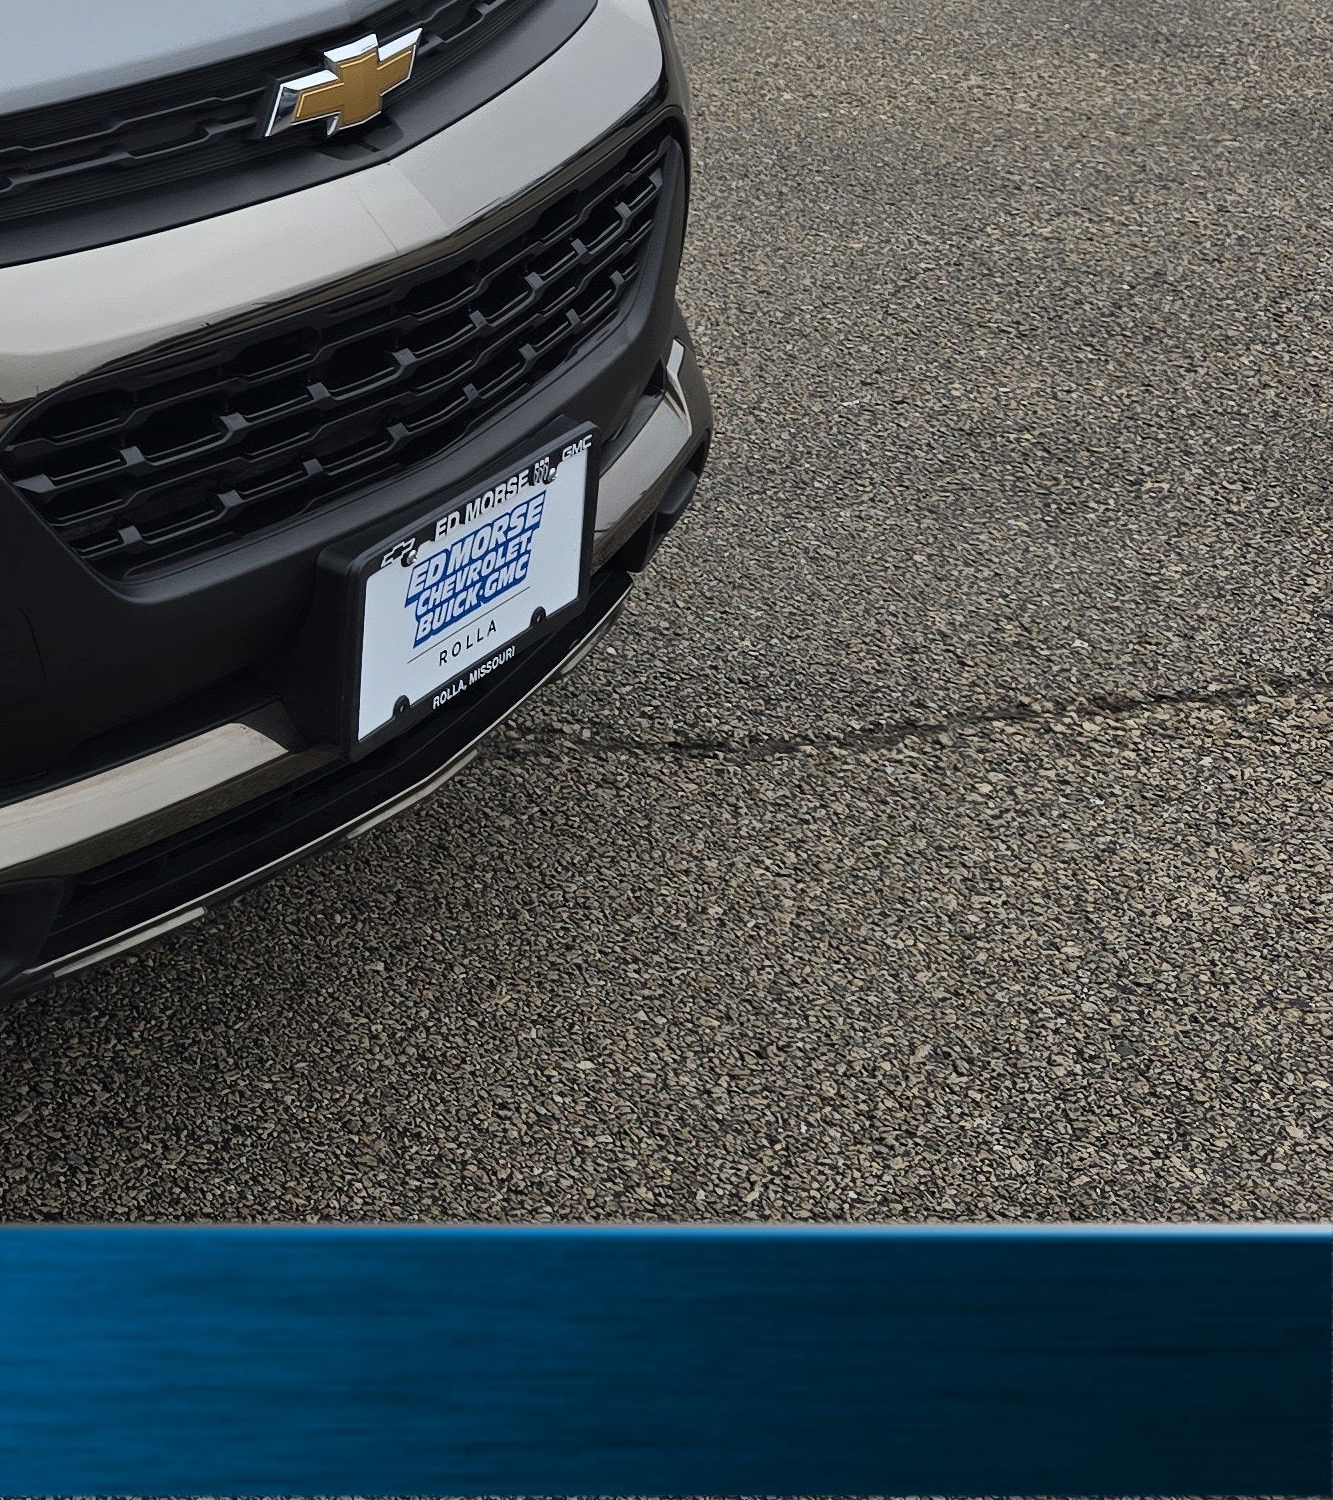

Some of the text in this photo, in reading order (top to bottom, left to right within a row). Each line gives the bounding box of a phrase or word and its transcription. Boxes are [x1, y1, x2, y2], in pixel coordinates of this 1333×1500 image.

[561, 434, 593, 461] GMC
[434, 469, 530, 541] ED MORSE
[407, 493, 545, 600] ED MORSE
[439, 619, 497, 666] ROLLA
[469, 645, 516, 686] MISSOURI
